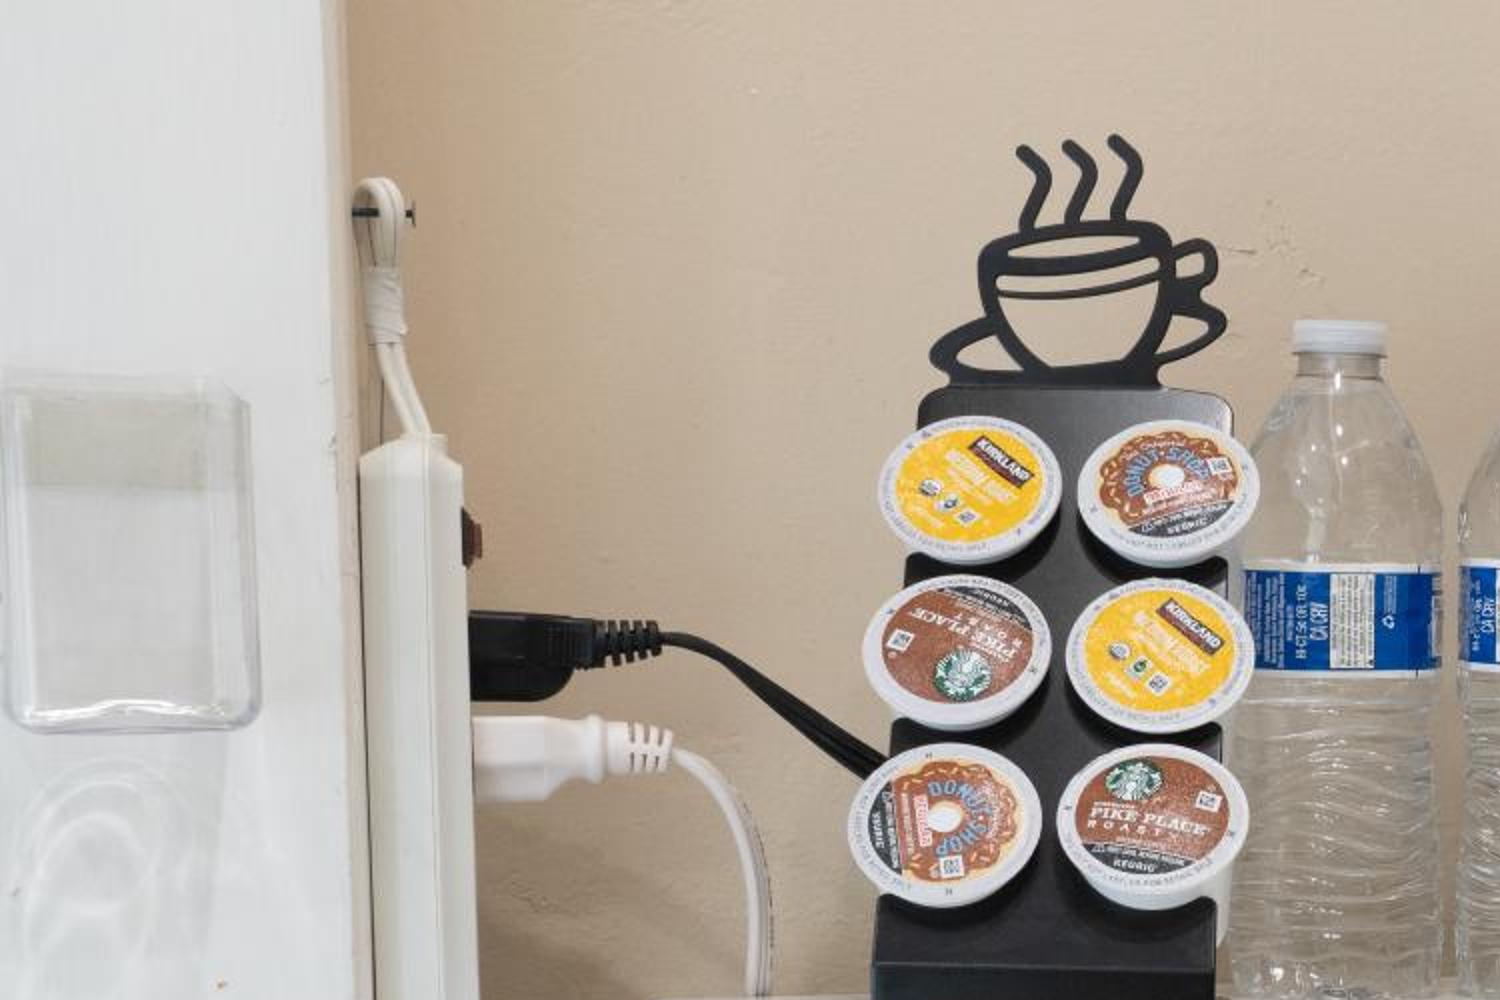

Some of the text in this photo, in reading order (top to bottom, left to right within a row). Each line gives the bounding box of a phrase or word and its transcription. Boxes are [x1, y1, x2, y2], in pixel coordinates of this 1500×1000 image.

[976, 438, 1030, 481] KIRKLAND
[1164, 601, 1222, 649] KIRKLAND
[1088, 820, 1162, 836] ROAST
[1090, 806, 1211, 837] PIKE PLACE
